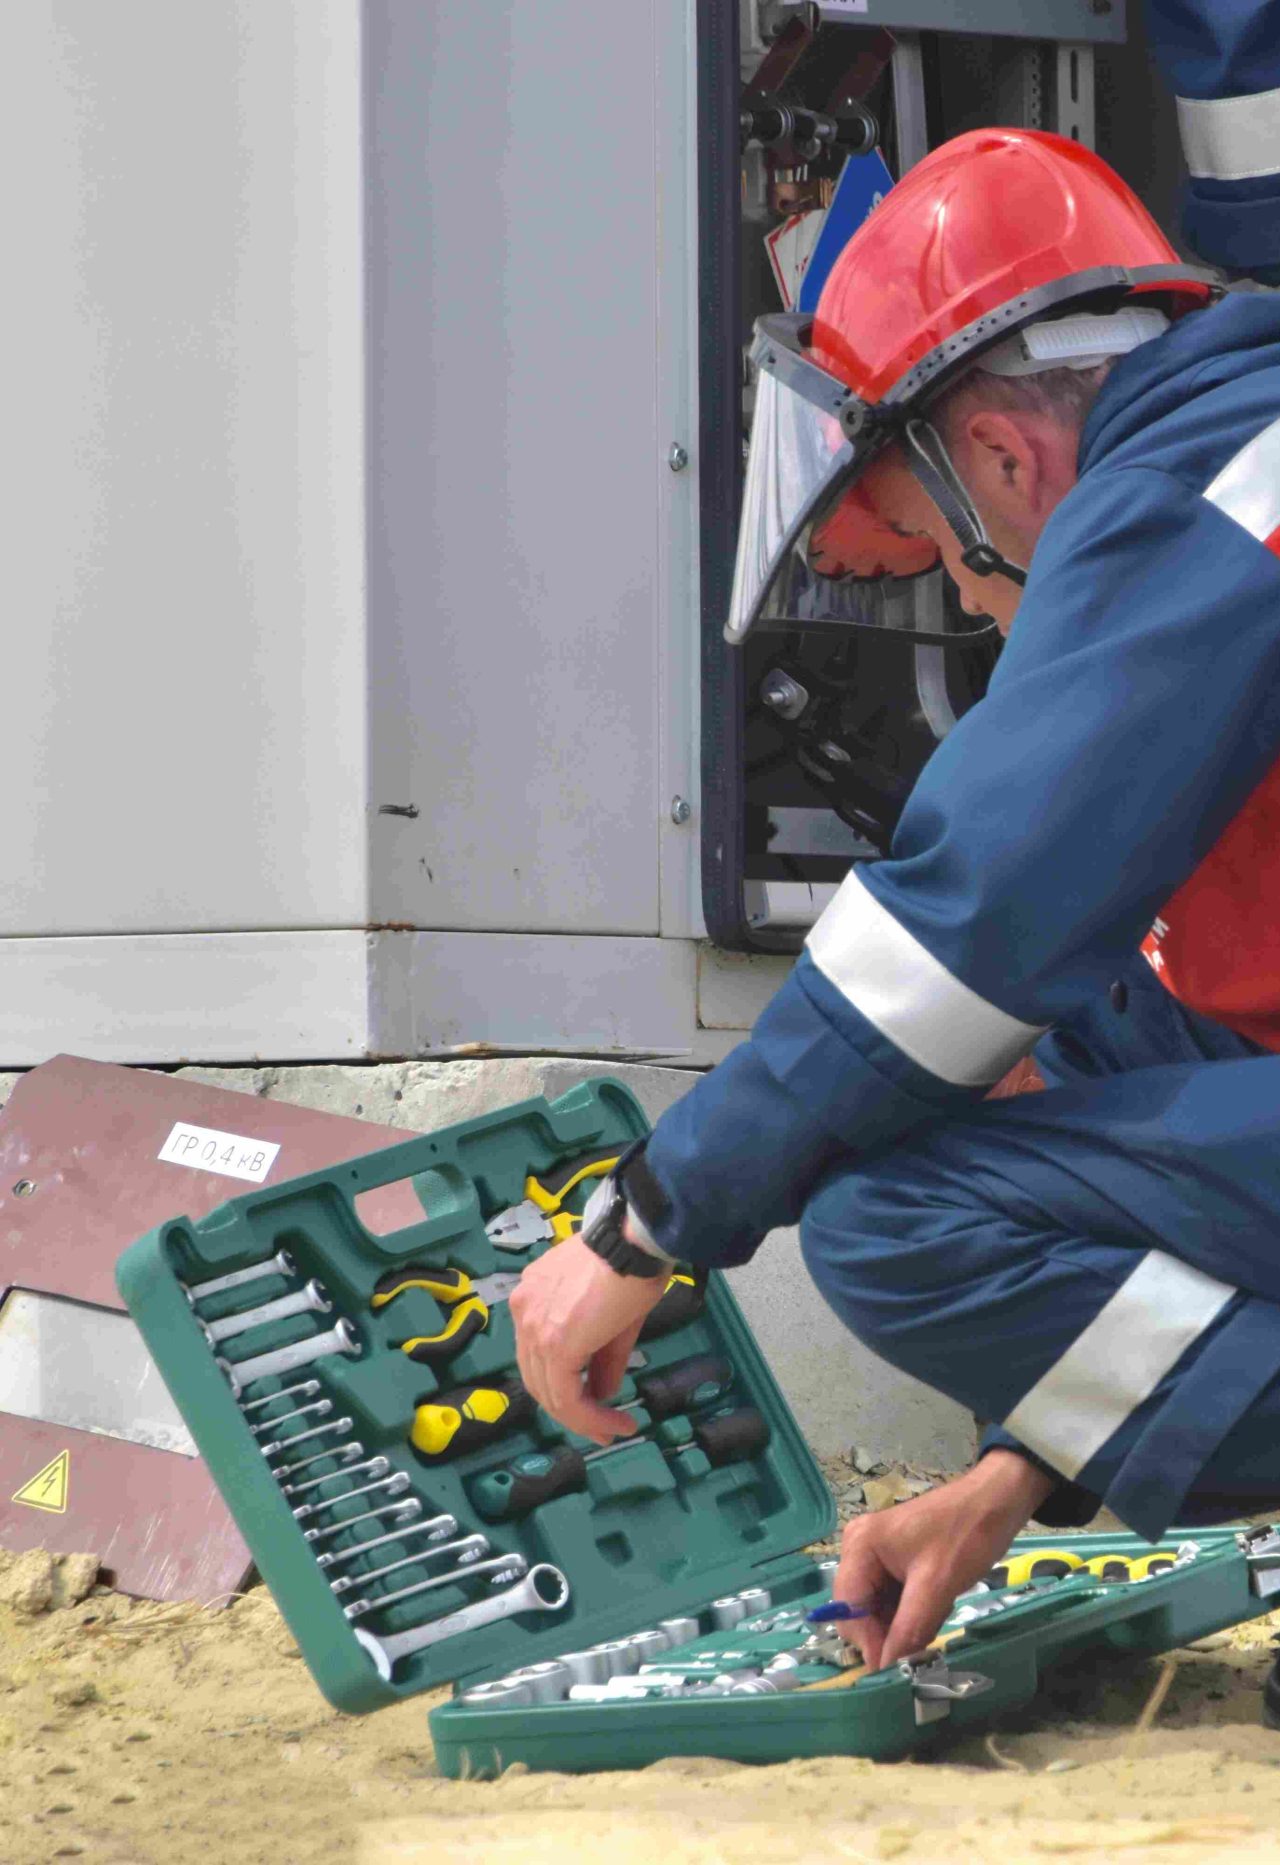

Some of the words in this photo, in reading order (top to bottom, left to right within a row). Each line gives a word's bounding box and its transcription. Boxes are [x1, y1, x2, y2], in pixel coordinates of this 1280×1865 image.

[171, 1133, 200, 1155] ГР
[201, 1140, 236, 1166] 0,4
[236, 1151, 266, 1172] кВ
